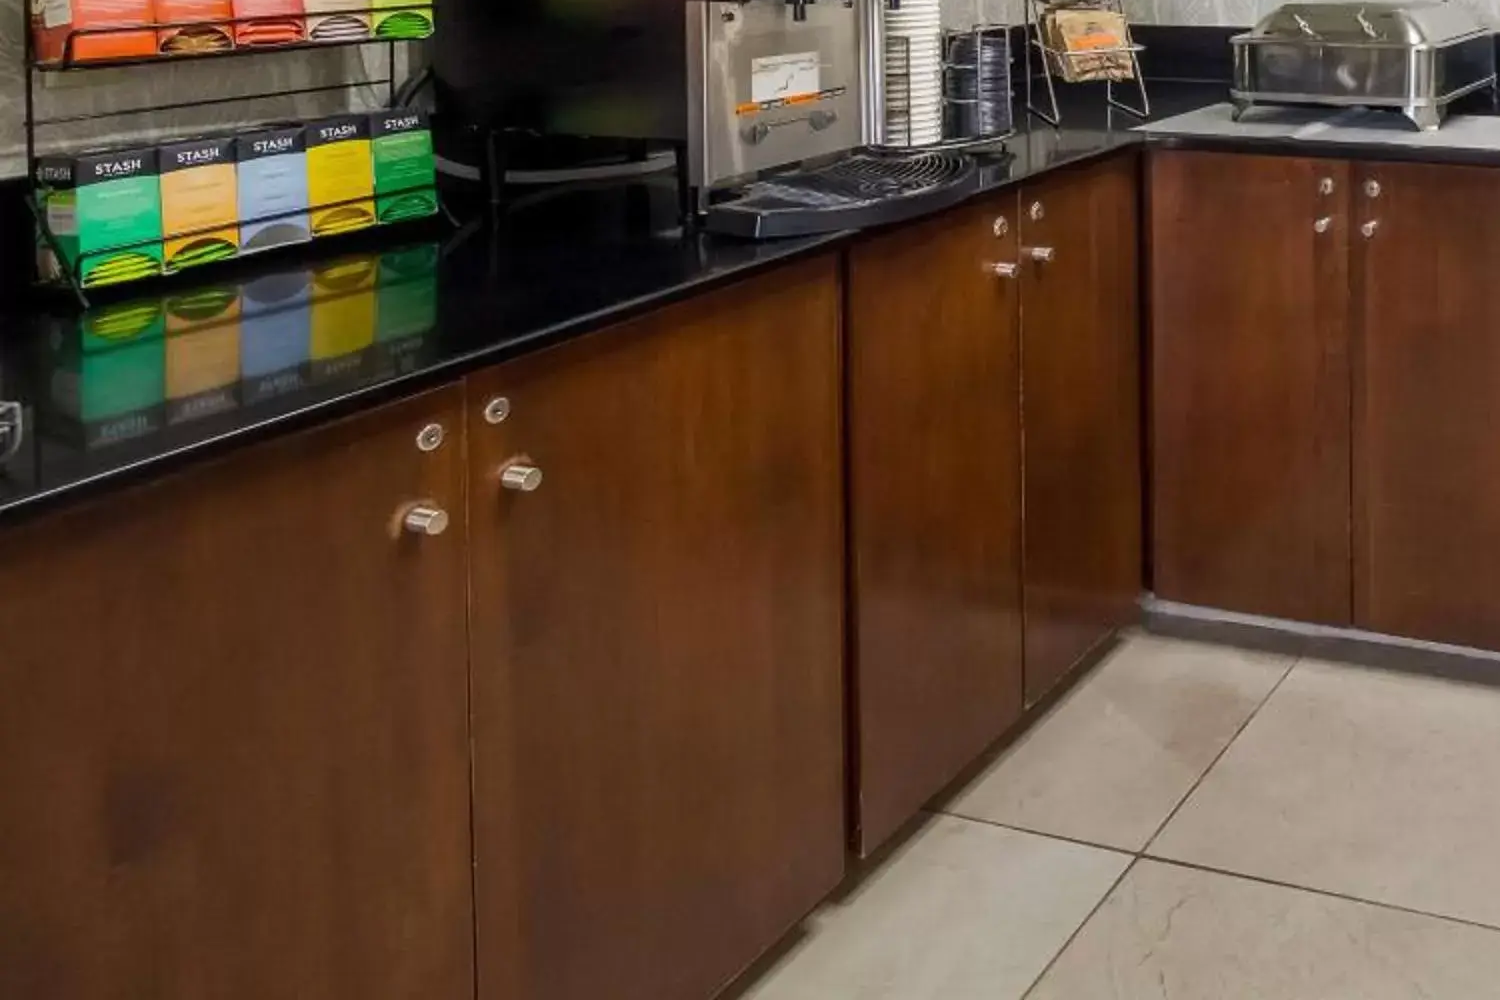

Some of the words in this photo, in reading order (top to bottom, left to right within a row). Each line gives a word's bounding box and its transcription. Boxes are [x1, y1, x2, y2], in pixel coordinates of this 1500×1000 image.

[384, 115, 419, 129] STASH
[319, 124, 357, 138] STASH
[253, 137, 293, 152] STASH
[177, 147, 219, 163] STASH
[95, 159, 141, 175] STASH
